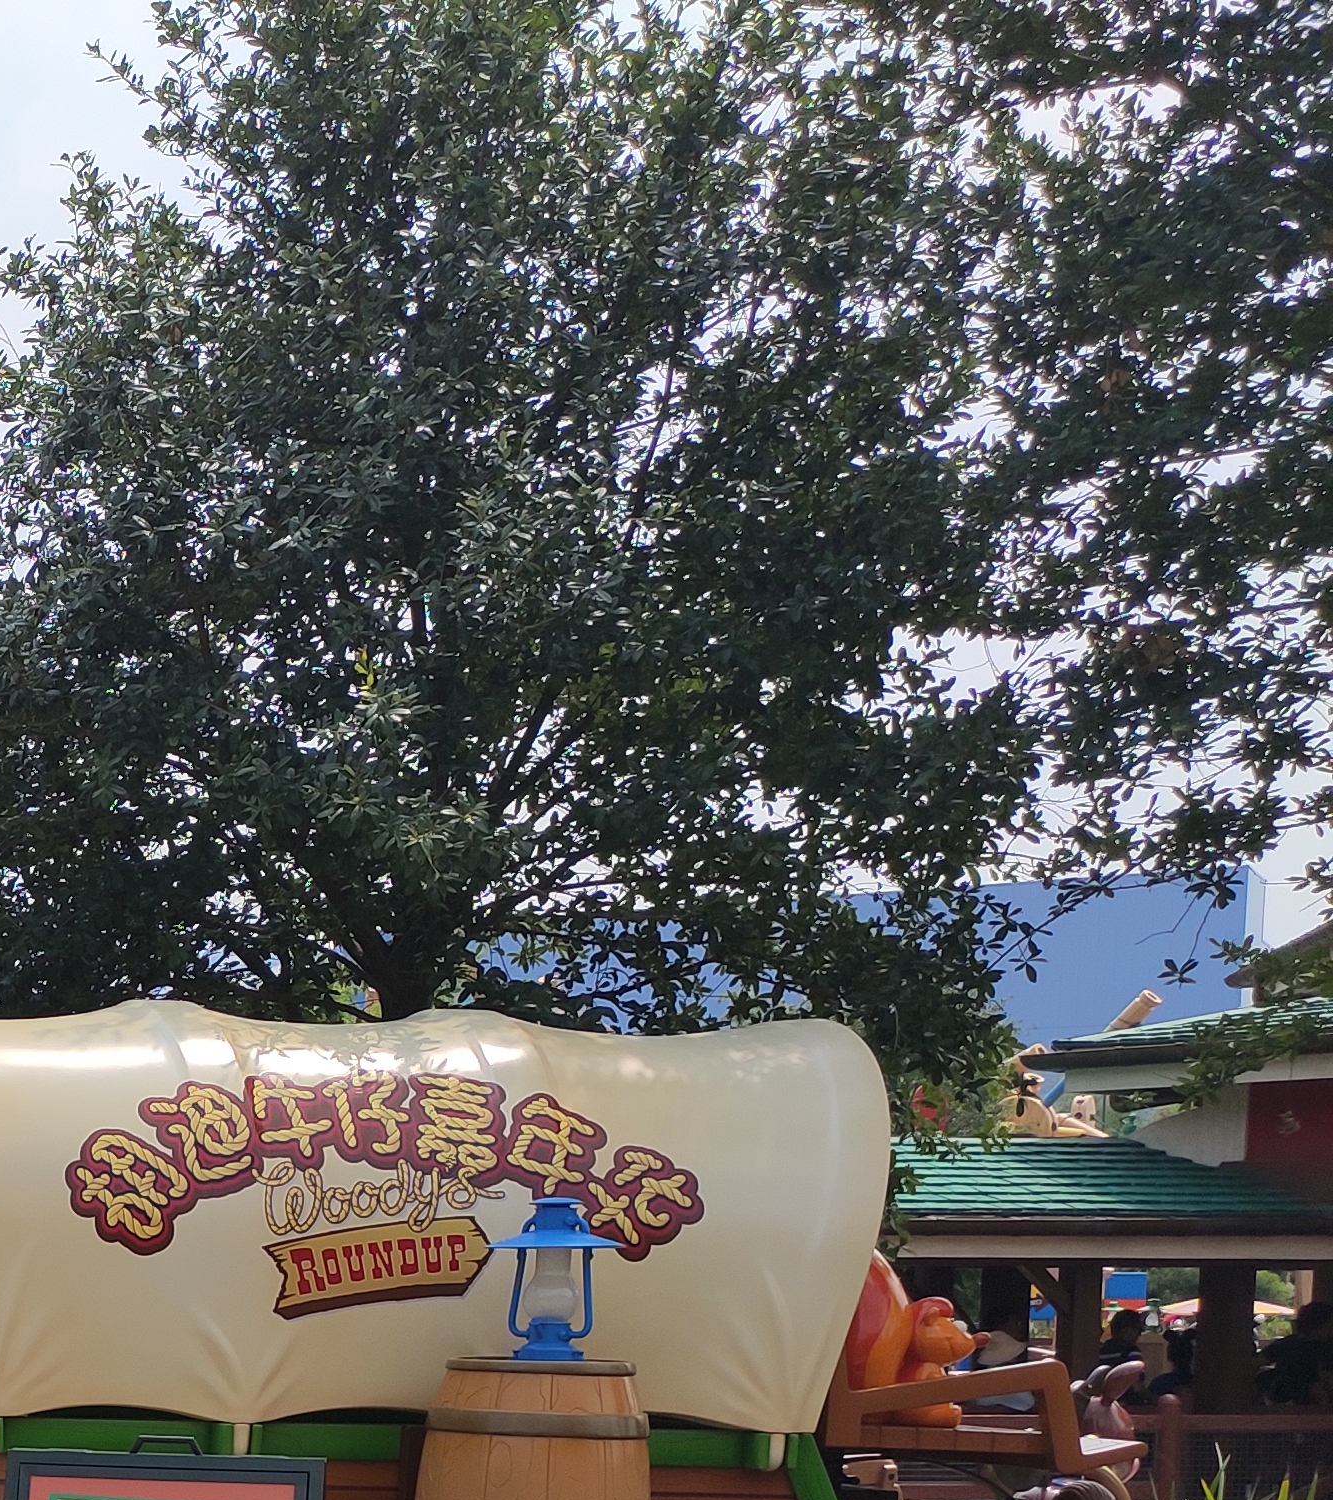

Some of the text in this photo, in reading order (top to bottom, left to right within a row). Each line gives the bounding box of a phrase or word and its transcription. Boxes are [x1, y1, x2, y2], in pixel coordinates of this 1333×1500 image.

[69, 1070, 699, 1257] 胡迪牛仔嘉年华
[290, 1233, 466, 1297] ROUNDUP
